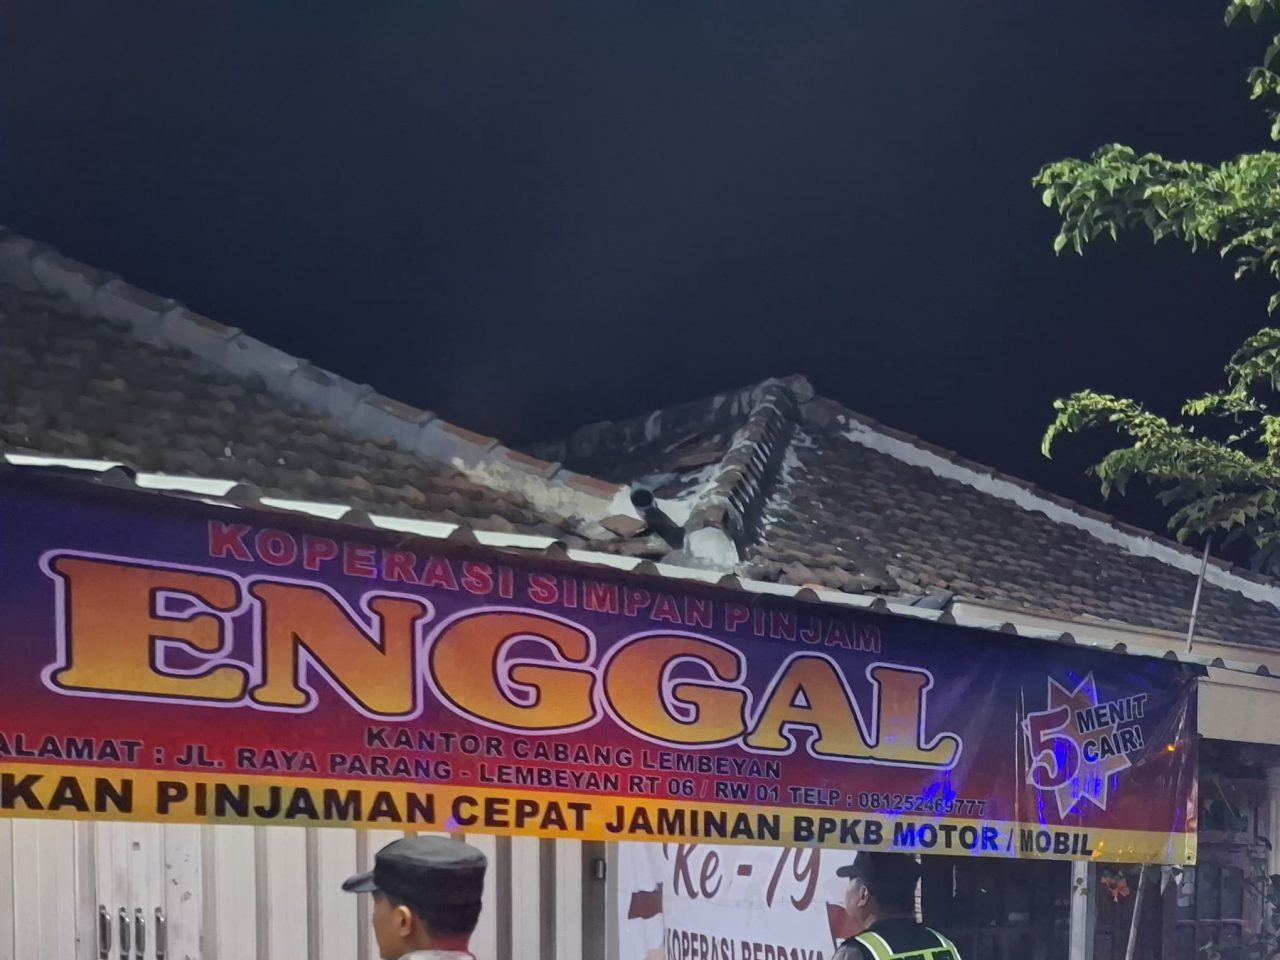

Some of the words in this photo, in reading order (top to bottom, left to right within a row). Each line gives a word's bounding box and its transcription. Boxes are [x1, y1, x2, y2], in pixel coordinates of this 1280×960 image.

[208, 520, 513, 599] KOPERASI
[528, 572, 713, 629] SIMPAN
[724, 603, 882, 654] PINJAM
[39, 548, 962, 770] ENGGAL
[176, 745, 223, 767] JL.
[237, 747, 317, 771] RAYA
[329, 753, 452, 780] PARANG
[479, 763, 619, 791] LEMBEYAN
[629, 774, 659, 794] RT
[668, 777, 694, 796] 06
[715, 782, 749, 800] RW
[756, 785, 780, 801] 01
[789, 787, 841, 806] TELP
[366, 727, 503, 757] KANTOR
[513, 738, 633, 768] CABANG
[642, 750, 781, 779] LEMBEYAN
[1027, 704, 1081, 790] 5
[1075, 693, 1147, 735] MENIT
[1082, 725, 1145, 764] CAIR!
[156, 780, 436, 824] PINJAMAN
[452, 795, 592, 831] CEPAT
[605, 805, 781, 841] JAMINAN
[794, 816, 883, 845] BPKB
[893, 822, 999, 851] MOTOR
[1020, 828, 1093, 856] MOBIL
